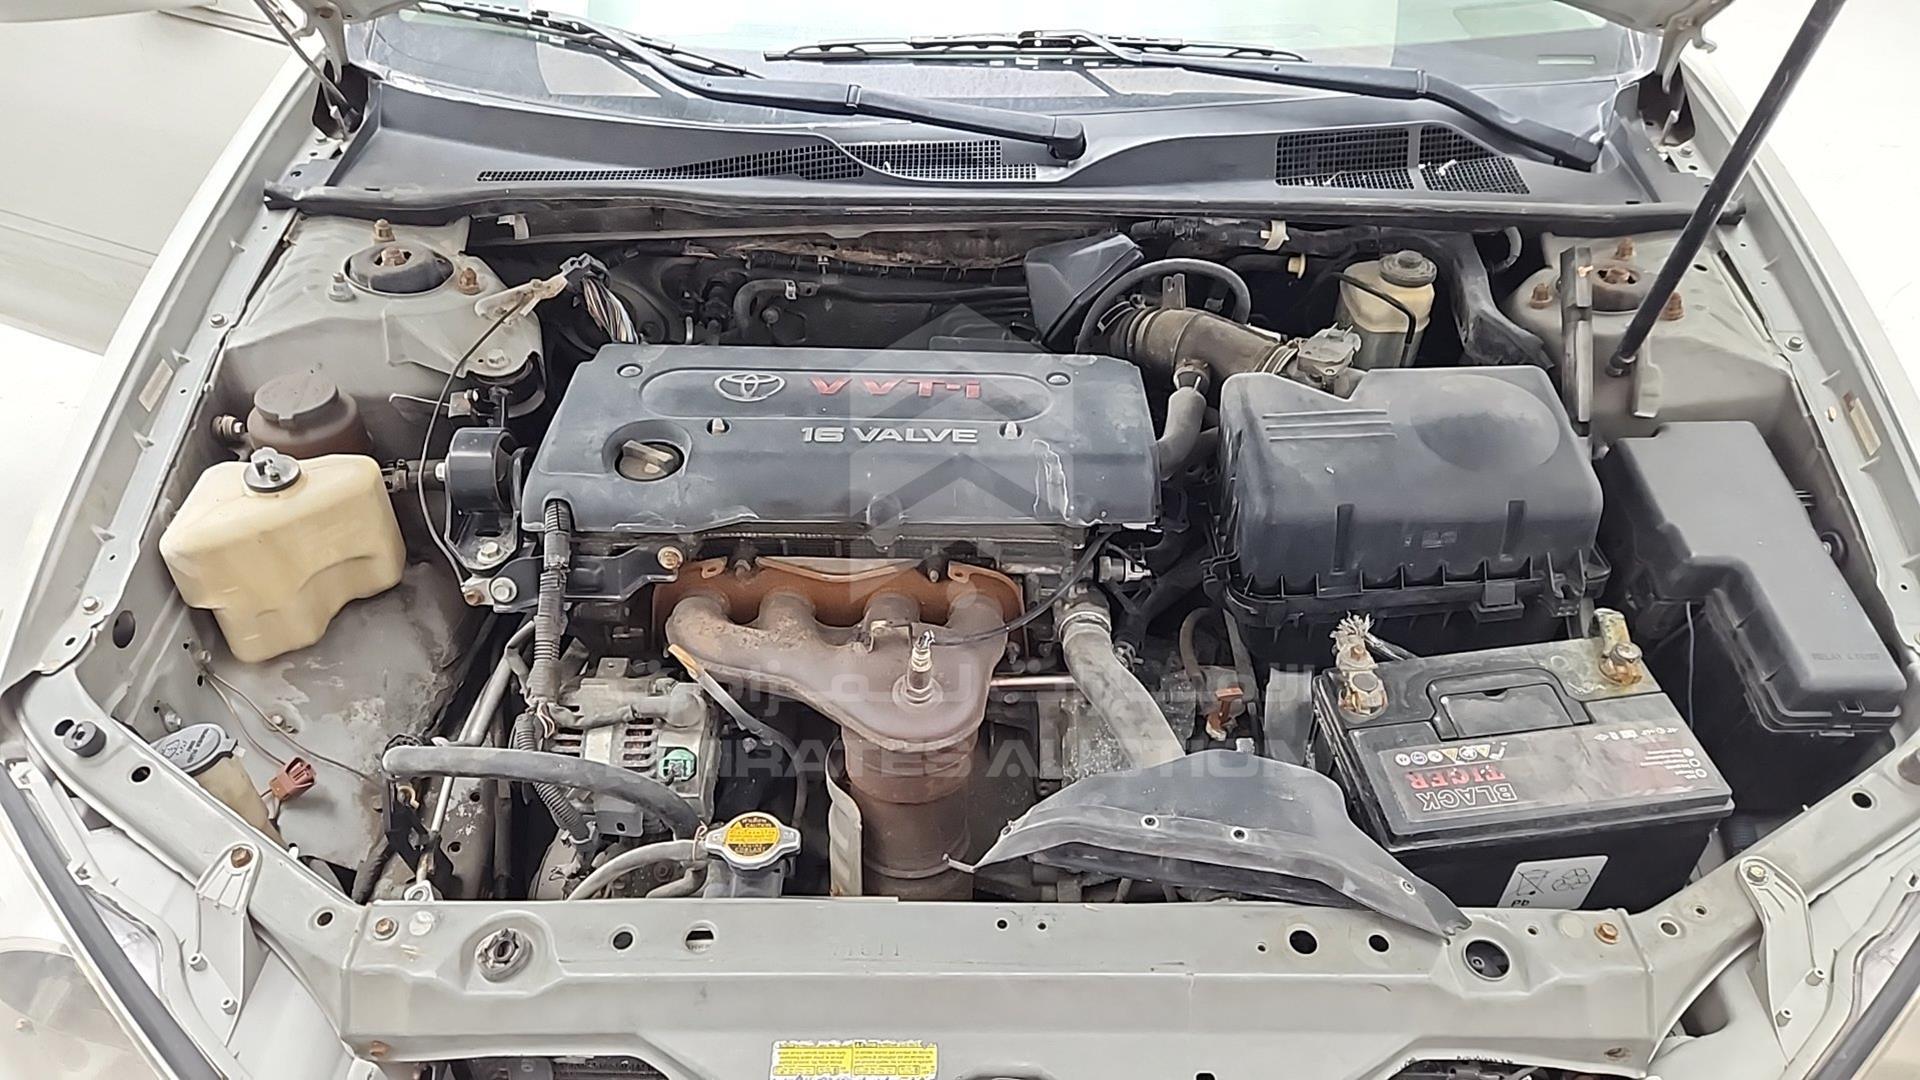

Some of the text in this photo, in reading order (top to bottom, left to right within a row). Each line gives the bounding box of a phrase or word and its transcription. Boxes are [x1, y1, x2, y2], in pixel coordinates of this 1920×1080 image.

[801, 426, 979, 444] 16 VALVE
[1405, 764, 1506, 790] TIGER
[1415, 782, 1519, 811] BLACK
